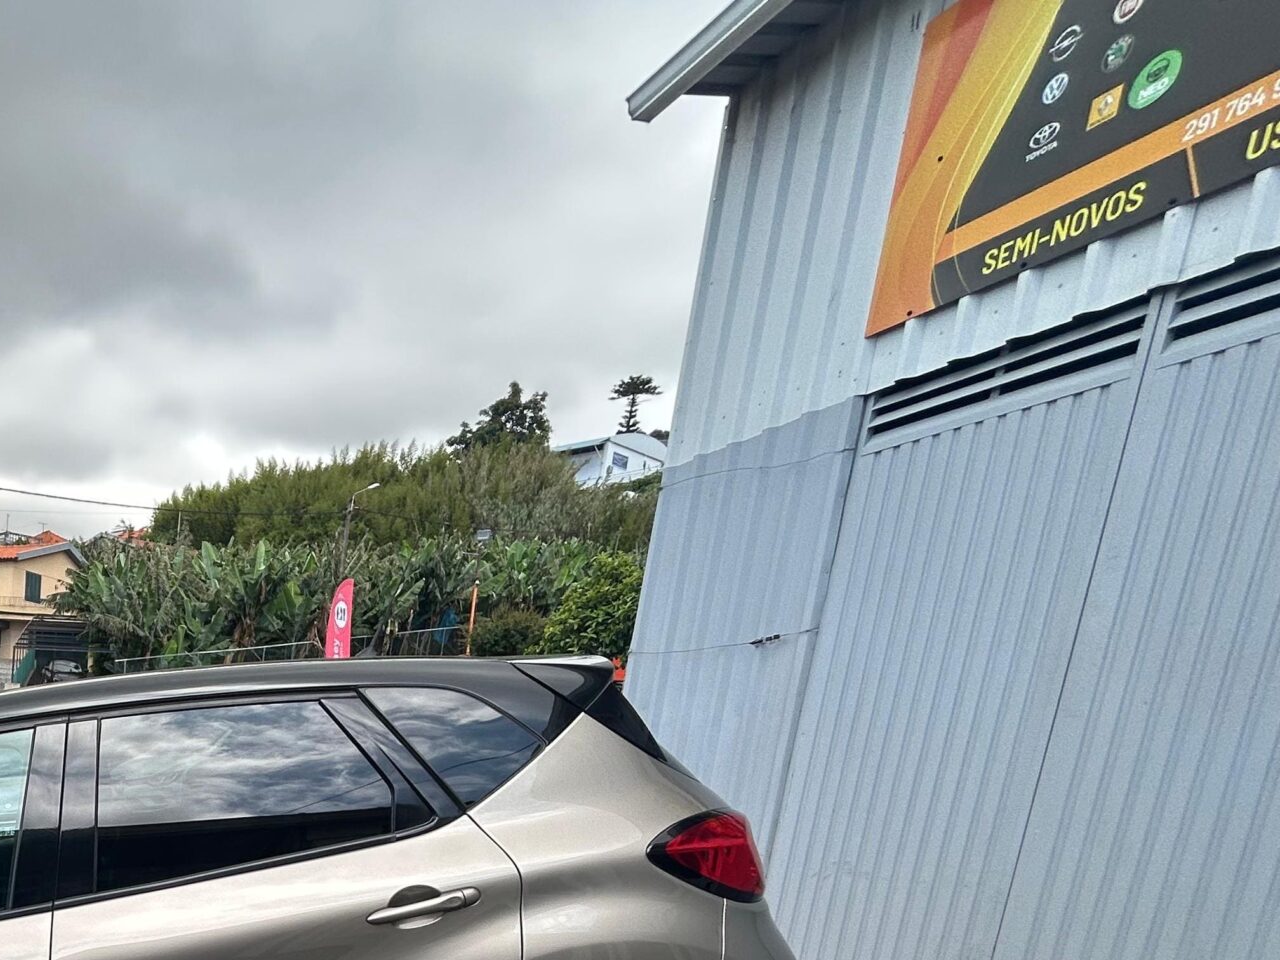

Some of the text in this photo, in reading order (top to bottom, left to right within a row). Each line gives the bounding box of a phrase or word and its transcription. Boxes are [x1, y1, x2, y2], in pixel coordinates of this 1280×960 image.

[1181, 108, 1221, 142] 291
[1225, 87, 1265, 121] 764
[1025, 141, 1058, 162] TOYOTA
[981, 180, 1147, 275] SEMI-NOVOS
